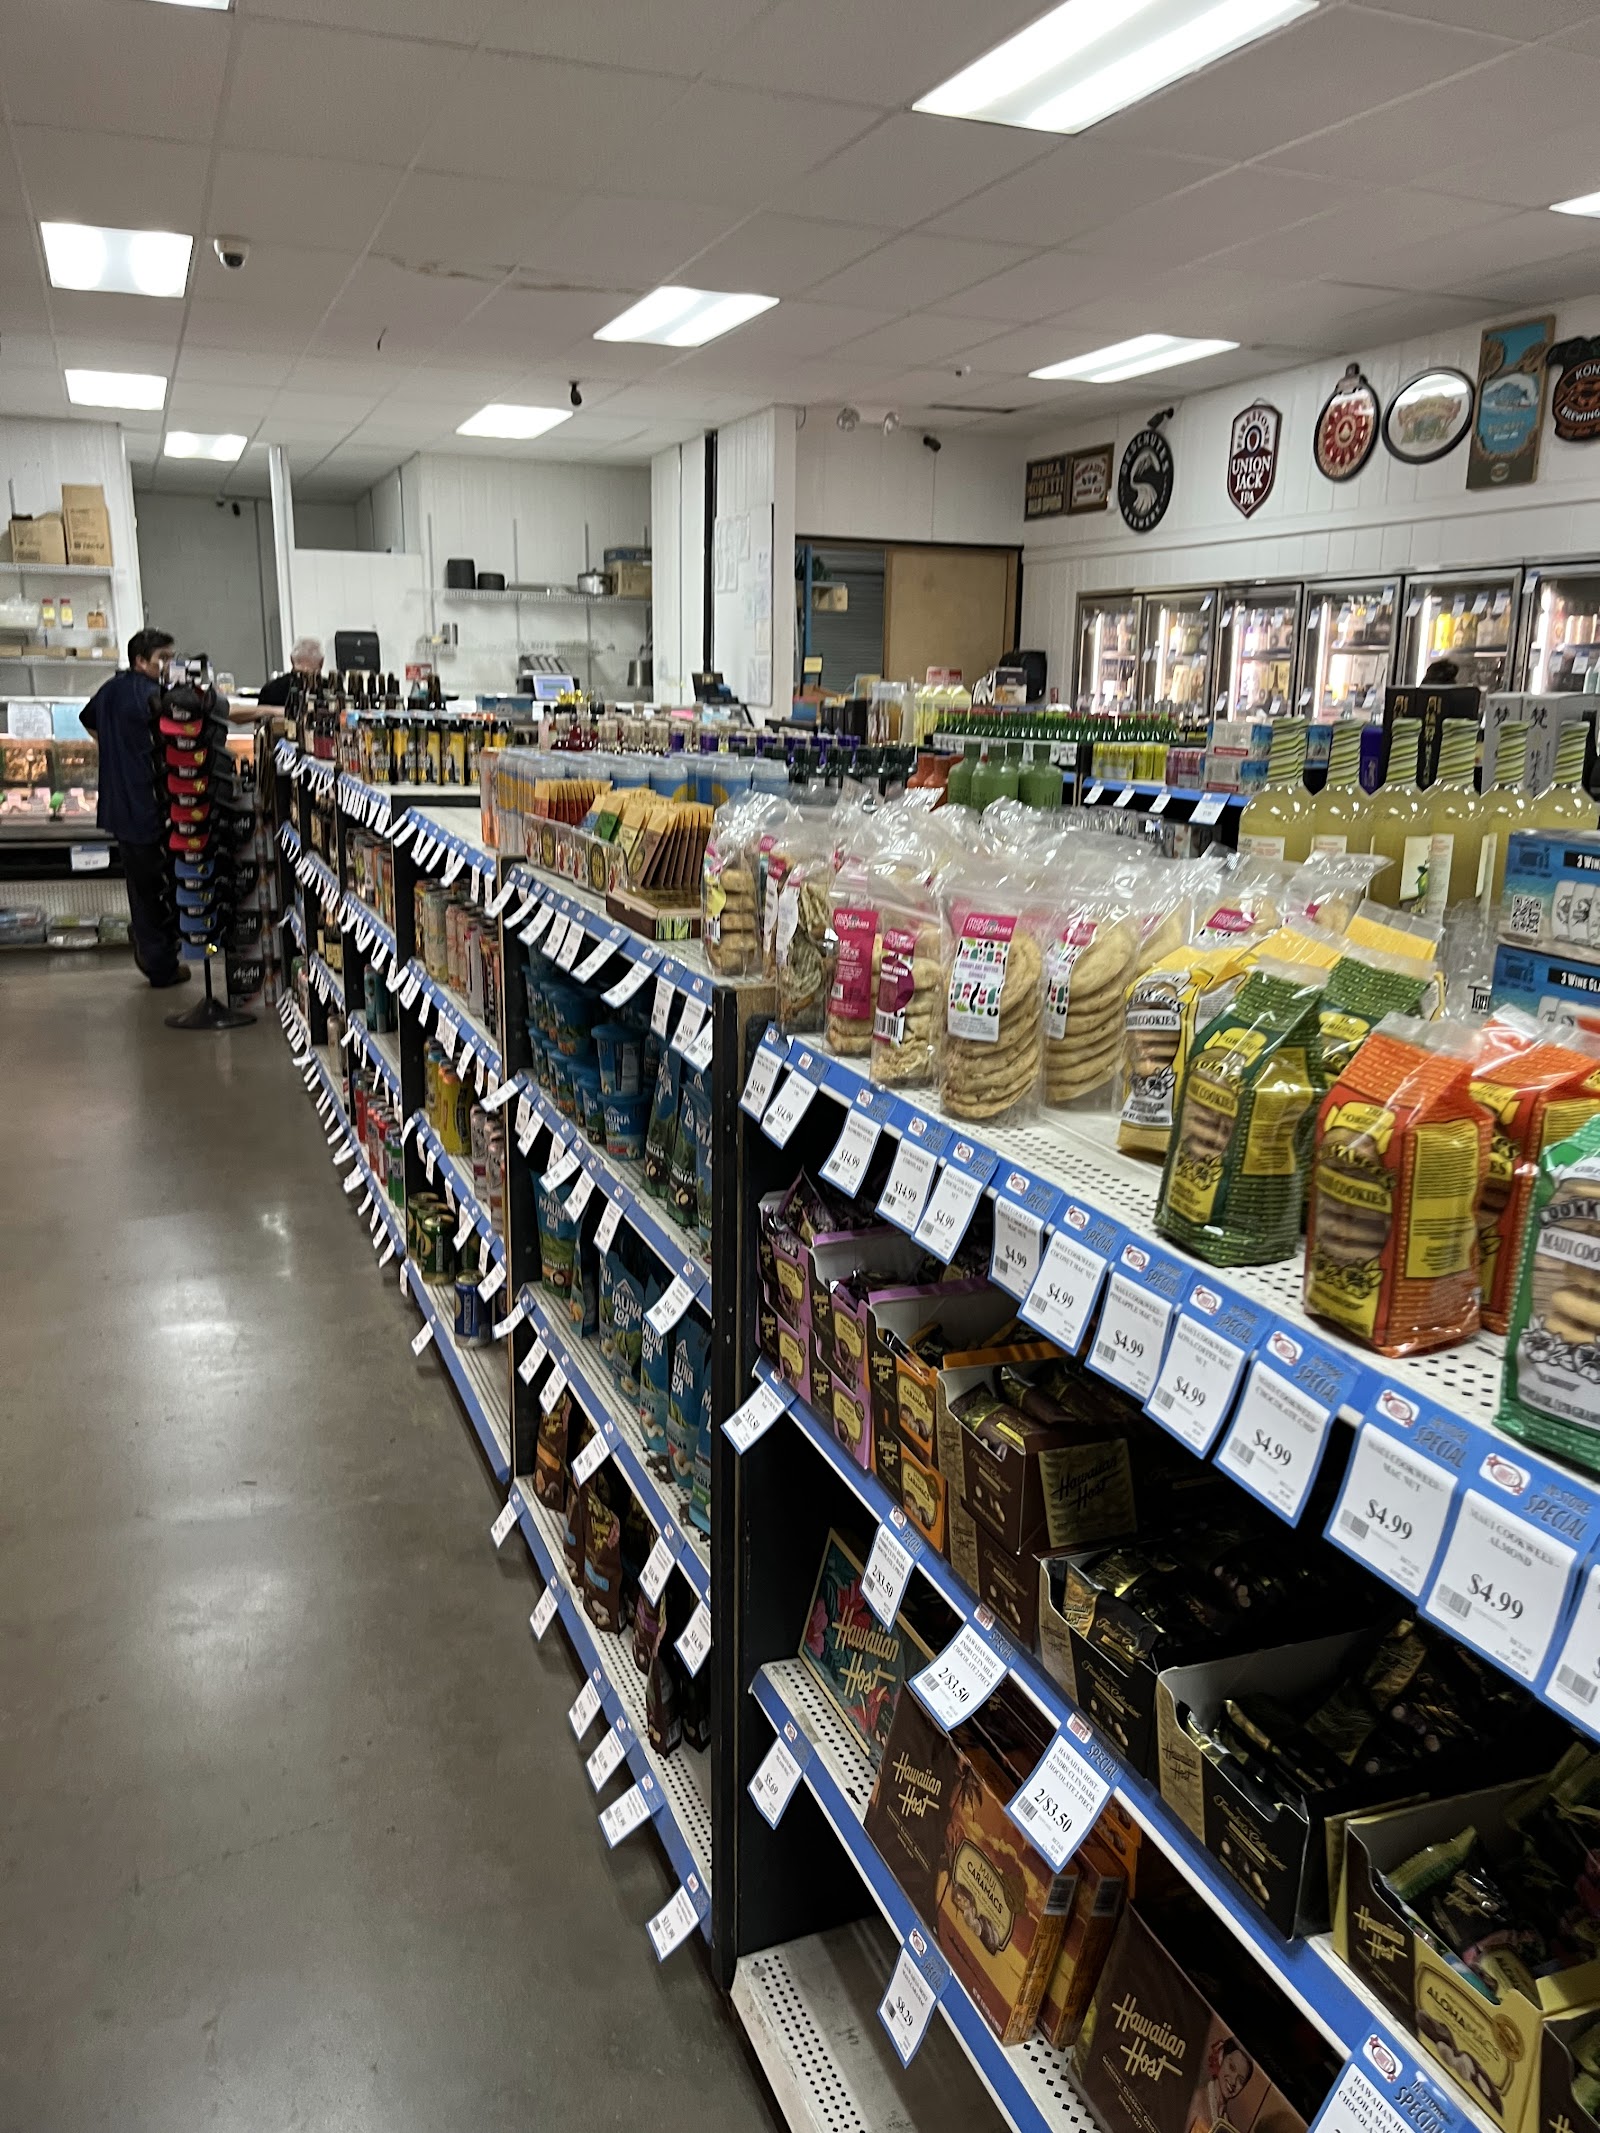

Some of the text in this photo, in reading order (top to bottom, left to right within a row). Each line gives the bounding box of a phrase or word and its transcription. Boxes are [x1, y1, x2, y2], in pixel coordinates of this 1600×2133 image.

[1121, 433, 1168, 475] DESCHUTES
[1232, 455, 1271, 473] UNION
[1234, 471, 1263, 493] JACK
[1240, 491, 1254, 504] IPA
[1577, 855, 1582, 867] 3
[1561, 972, 1567, 985] 3
[1568, 974, 1588, 988] WINE
[1138, 1014, 1177, 1026] COOKIES
[774, 1106, 794, 1123] $14.99
[838, 1148, 861, 1170] $14.99
[892, 1179, 918, 1203] $14.99
[933, 1207, 956, 1231] $4.99
[1004, 1242, 1027, 1270] $4.99
[1048, 1247, 1074, 1267] COCONUT
[1083, 1228, 1115, 1254] SPECIAL
[1543, 1232, 1574, 1255] MAUI
[1044, 1280, 1076, 1313] $4.99
[1144, 1268, 1180, 1297] SPECIAL
[613, 1309, 630, 1330] LOA
[1107, 1290, 1140, 1315] PINEAPPLE
[1111, 1327, 1146, 1362] $4.99
[1214, 1312, 1255, 1344] SPECIAL
[1171, 1372, 1208, 1411] $4.99
[1294, 1364, 1341, 1403] SPECIAL
[1249, 1425, 1294, 1470] $4.99
[1412, 1426, 1468, 1468] SPECIAL
[1050, 1454, 1124, 1502] Hawaiian
[1068, 1471, 1123, 1511] Host
[1363, 1495, 1416, 1544] $4.99
[1524, 1493, 1588, 1542] SPECIAL
[900, 1527, 921, 1555] SPECIAL
[1485, 1533, 1534, 1569] ALMOND
[871, 1561, 895, 1601] 2/$3.50
[1464, 1568, 1527, 1626] $4.99
[832, 1605, 899, 1662] Hawaiian
[964, 1631, 987, 1658] HAWAIIAN
[982, 1653, 997, 1670] HOST
[988, 1629, 1014, 1660] SPECIAL
[839, 1652, 896, 1698] Host
[951, 1642, 977, 1674] CHOCOLATE
[976, 1671, 990, 1689] PIECE
[980, 1663, 994, 1680] MILK
[936, 1663, 971, 1707] 2/$3.50
[892, 1751, 942, 1797] Hawaiian
[1056, 1745, 1085, 1777] HAWAIIAN
[1081, 1771, 1098, 1790] HOST
[1086, 1743, 1118, 1781] SPECIAL
[762, 1771, 779, 1798] $5.69
[898, 1784, 940, 1818] Host
[1043, 1758, 1076, 1795] CHOCOLATE
[1076, 1792, 1095, 1815] PIECE
[1080, 1782, 1098, 1804] DARK
[1032, 1786, 1074, 1836] 2/$3.50
[966, 1861, 1004, 1914] CARAMACS
[978, 1862, 997, 1888] MAUI
[1353, 1904, 1405, 1947] Hawaiian
[1364, 1932, 1409, 1963] Host
[894, 1992, 914, 2031] $8.29
[1111, 1992, 1187, 2059] Hawaiian
[1120, 2036, 1183, 2082] Host
[1102, 2056, 1143, 2113] GENUINE CLASSIC
[1347, 2085, 1373, 2118] ALOHA
[1353, 2076, 1393, 2122] HAWAIIAN
[1117, 2095, 1132, 2116] SINCE
